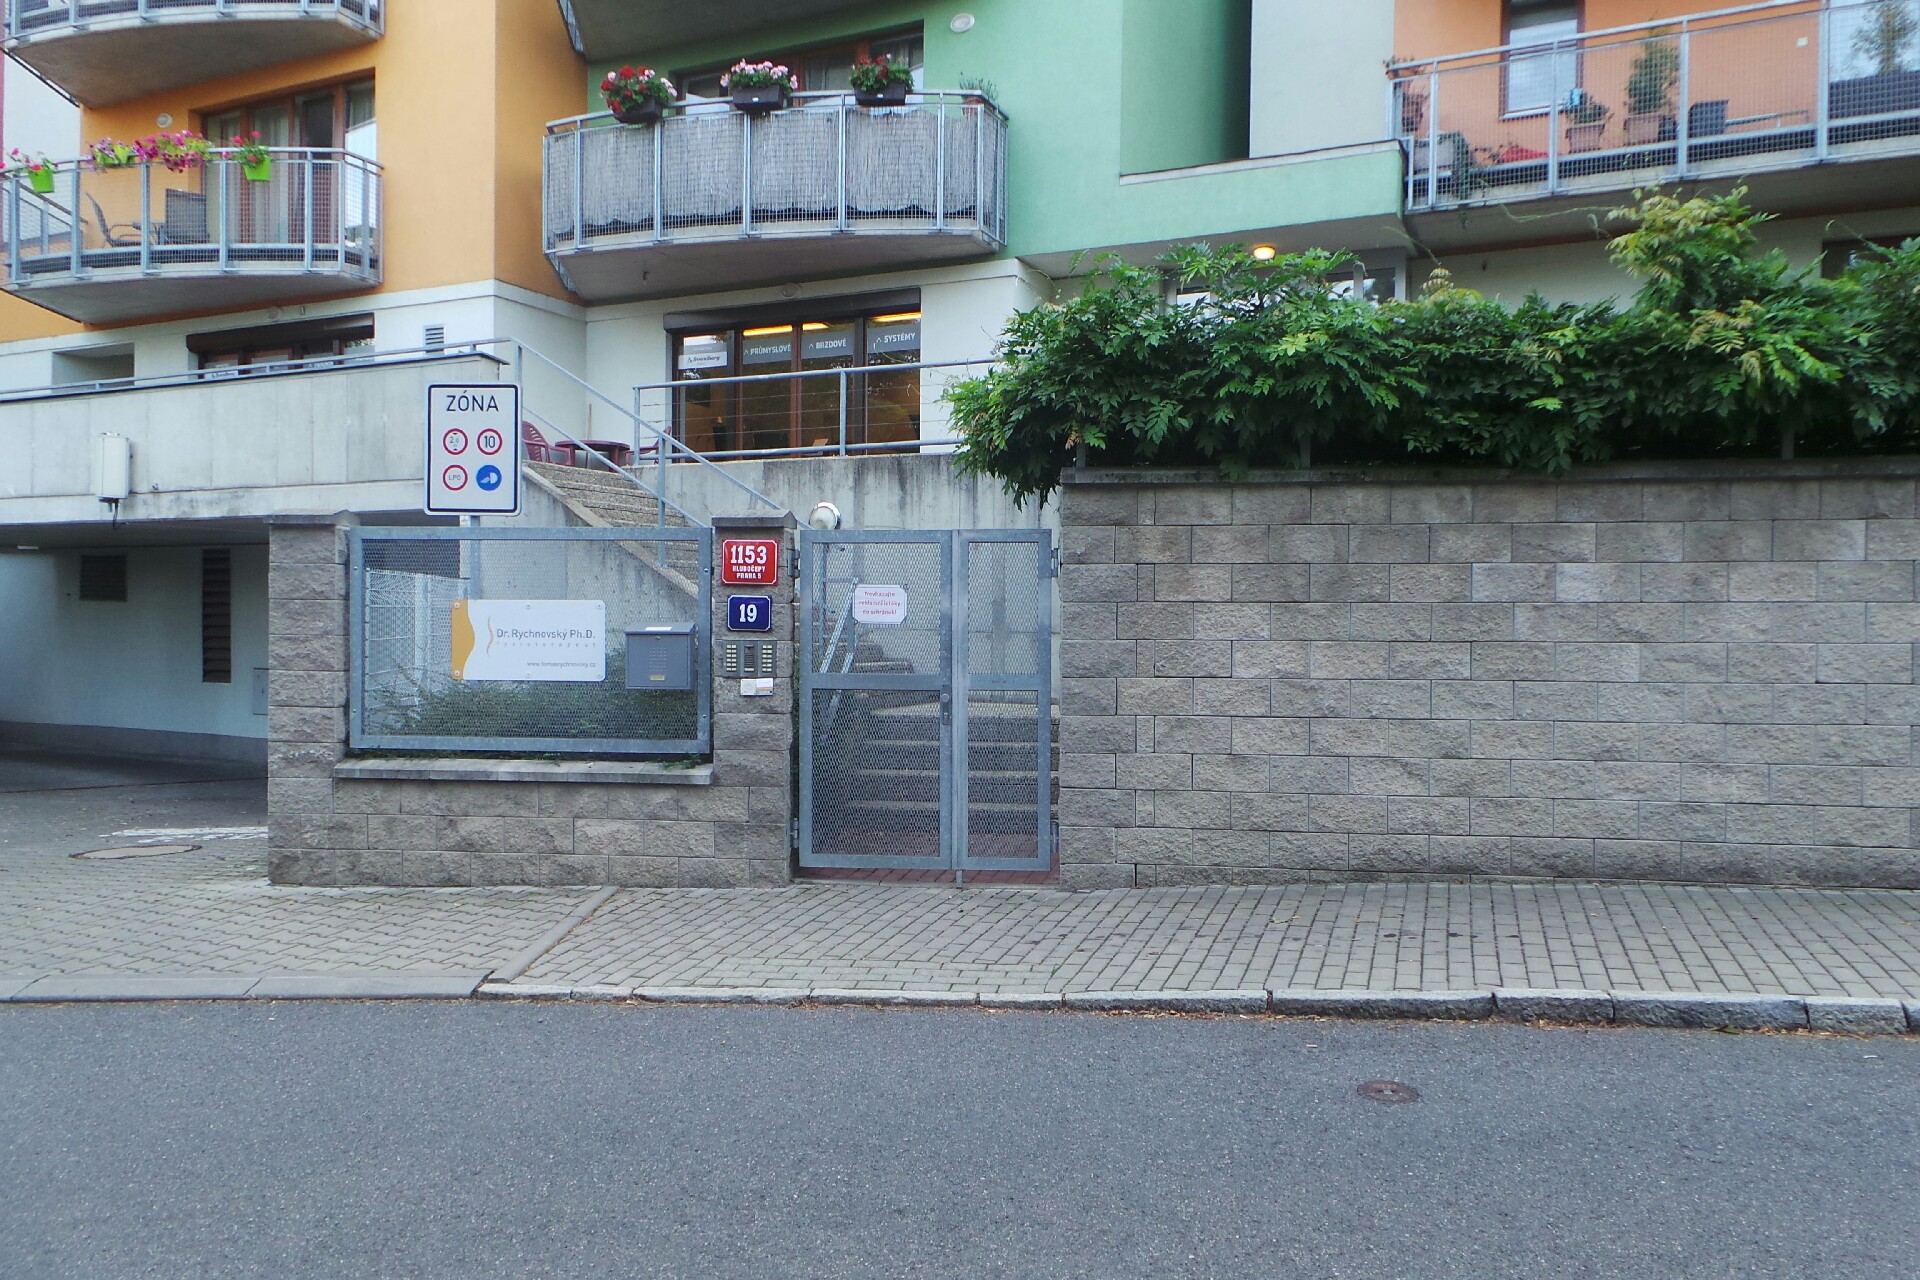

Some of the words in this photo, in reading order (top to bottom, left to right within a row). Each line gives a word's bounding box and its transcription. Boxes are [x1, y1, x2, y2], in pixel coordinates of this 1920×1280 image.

[750, 343, 791, 356] PRŮMYSLOVÉ
[815, 338, 847, 349] BRZDOVÉ
[884, 332, 916, 343] SYSTÉMY
[446, 390, 499, 412] ZÓNA
[484, 435, 496, 448] 10
[730, 545, 767, 564] 1153
[732, 565, 766, 573] HLUBOČEPY
[739, 603, 758, 623] 19
[496, 628, 510, 638] Dr.
[511, 628, 568, 640] Rychnovský
[569, 629, 596, 639] Ph.D.
